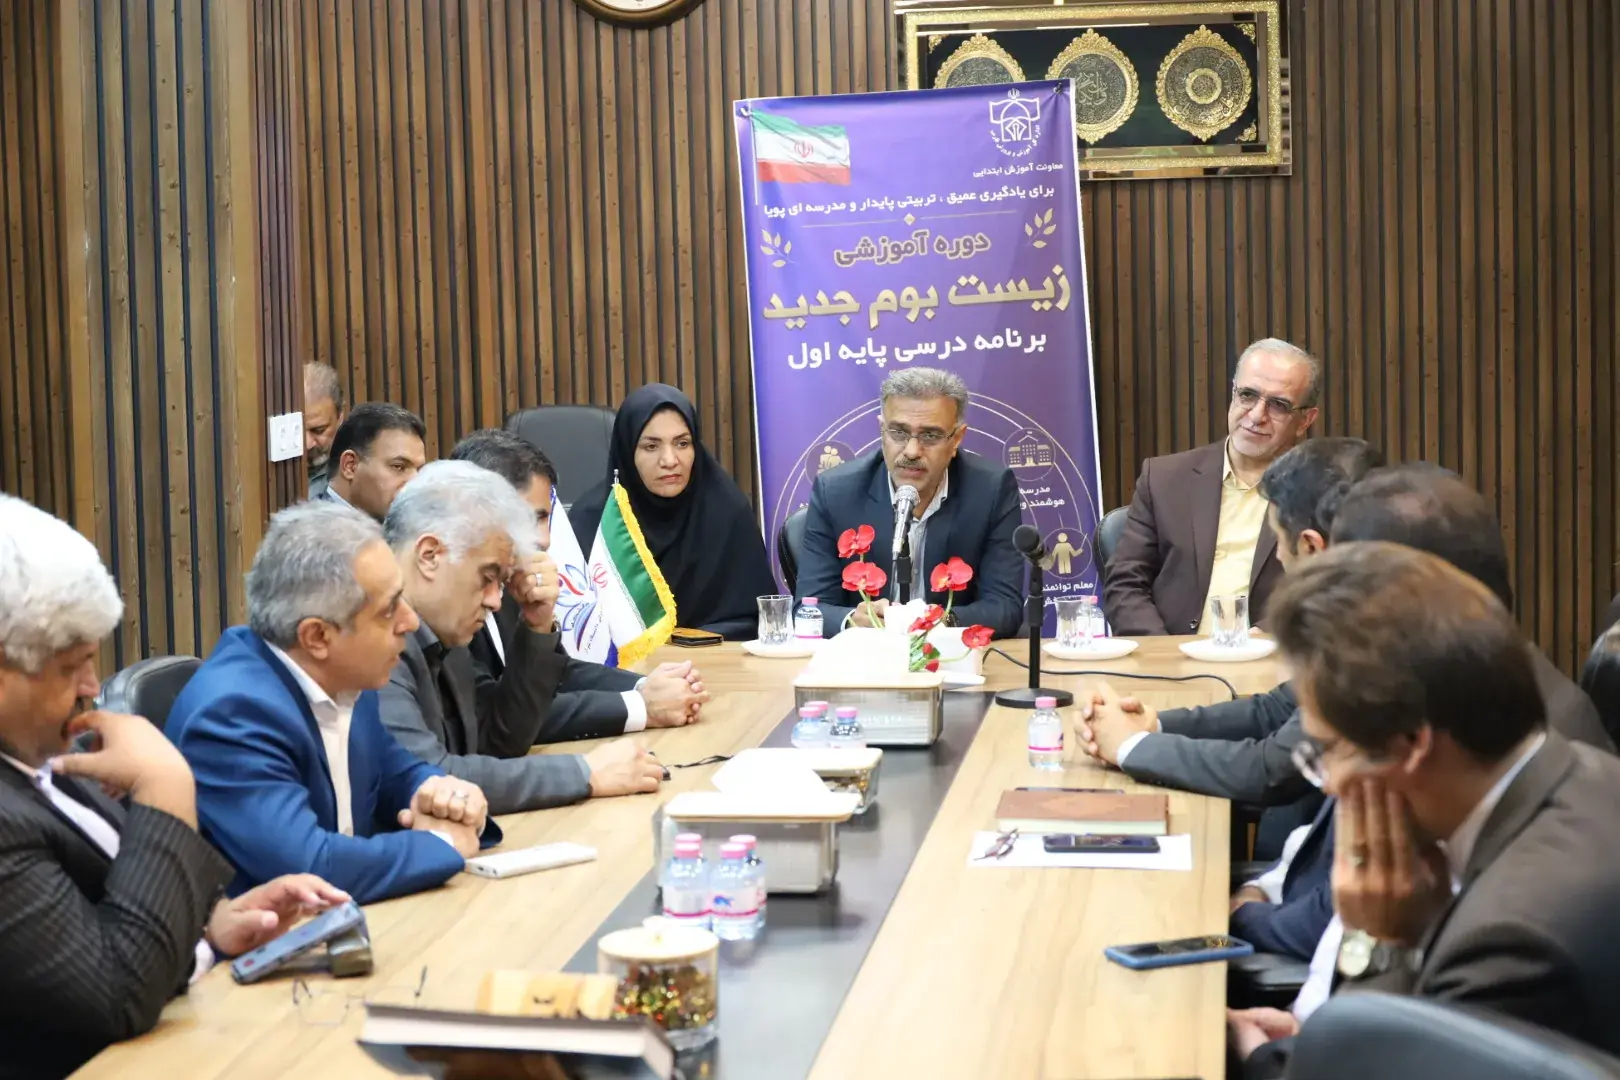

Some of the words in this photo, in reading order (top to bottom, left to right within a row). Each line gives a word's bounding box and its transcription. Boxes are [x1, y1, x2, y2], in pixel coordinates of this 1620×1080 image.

[972, 166, 1002, 178] ابتدایی
[1004, 162, 1034, 175] آموزش
[1036, 162, 1064, 172] معاونت
[946, 191, 977, 205] عمیق
[979, 185, 1026, 202] یادگیری
[1029, 185, 1055, 198] برای
[805, 201, 846, 214] مدرسه
[849, 201, 857, 212] و
[859, 196, 895, 211] پایدار
[897, 193, 937, 208] تربیتی
[763, 204, 786, 218] پویا
[788, 202, 803, 216] ای
[834, 228, 931, 267] آموزشی
[934, 230, 991, 260] دوره
[948, 264, 1072, 311] زیست
[762, 287, 861, 330] جدید
[868, 282, 940, 330] بوم
[894, 333, 968, 362] درسی
[973, 327, 1048, 353] برنامه
[787, 340, 831, 370] اول
[837, 337, 888, 368] پایه
[1029, 498, 1065, 507] هوشمند
[1073, 580, 1094, 592] معلم
